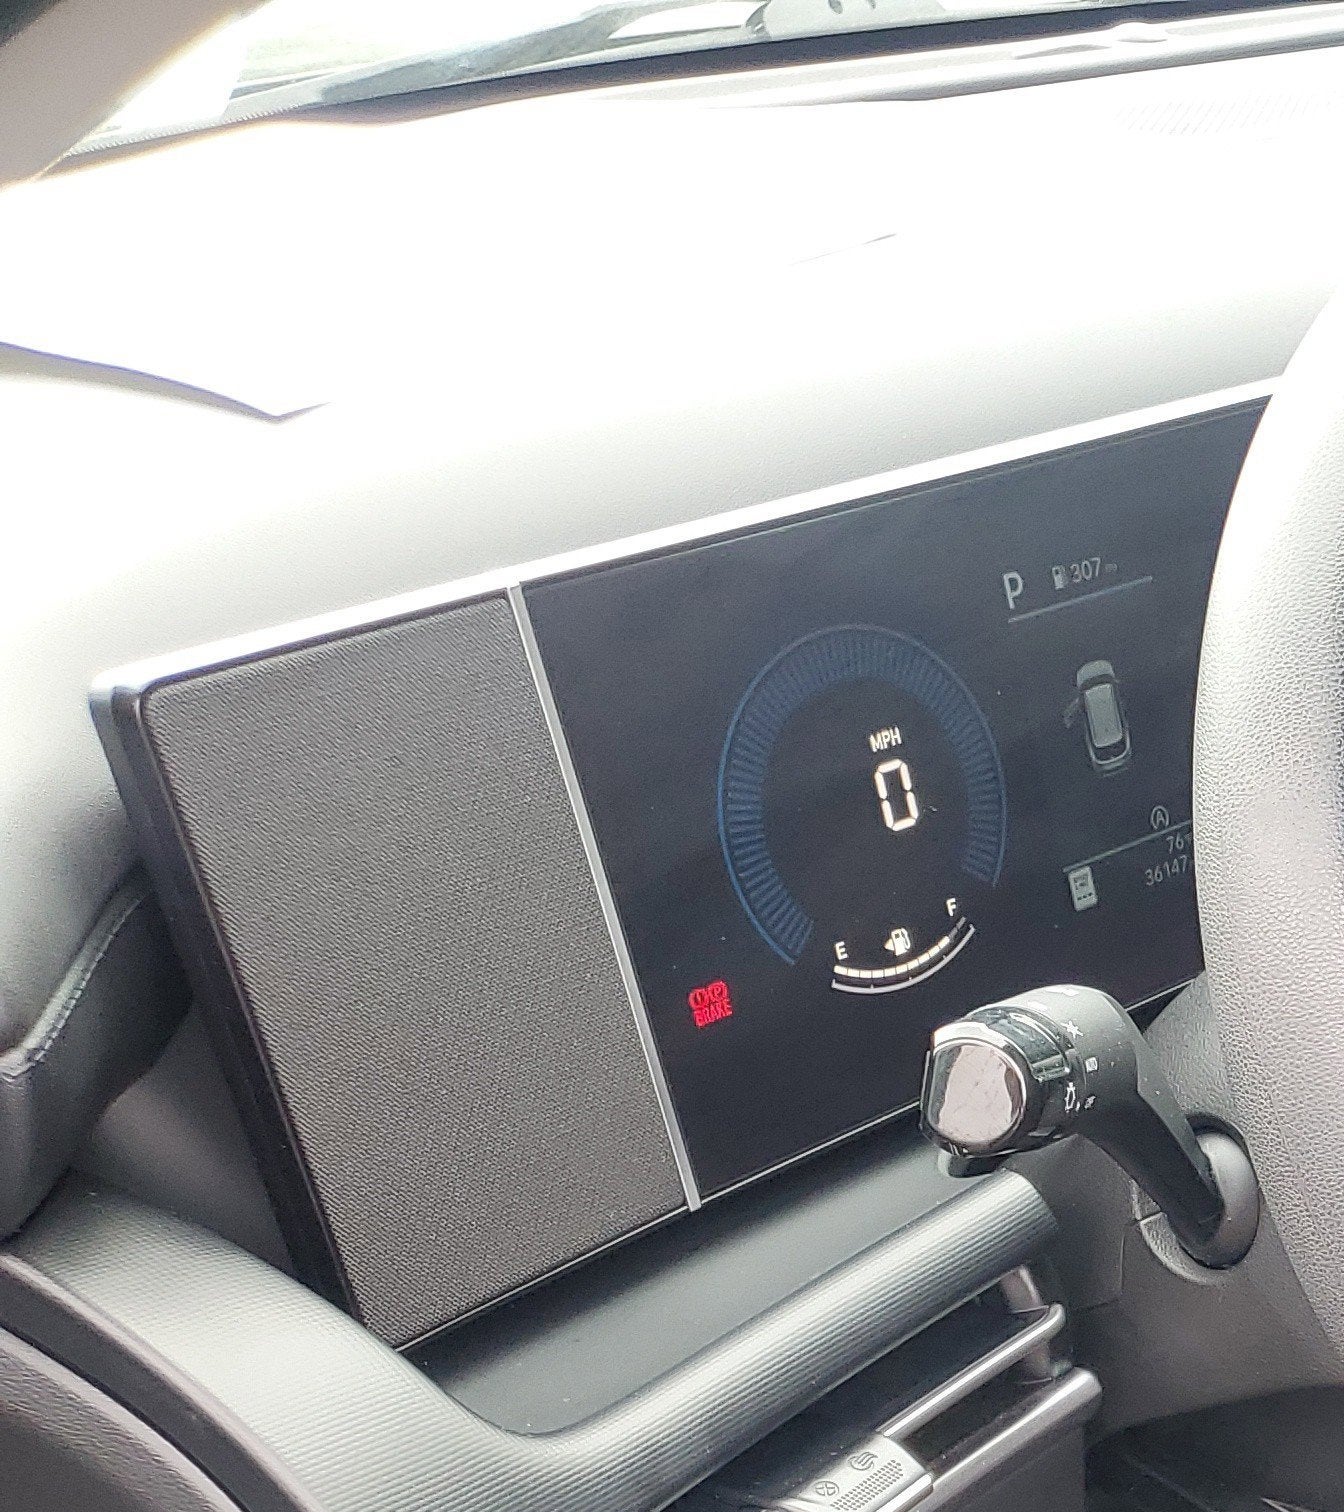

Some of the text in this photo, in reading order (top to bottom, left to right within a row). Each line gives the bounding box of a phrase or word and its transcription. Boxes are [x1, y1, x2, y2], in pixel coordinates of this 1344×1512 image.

[1069, 557, 1101, 583] 307
[1004, 571, 1023, 609] P
[869, 727, 902, 752] MPH
[874, 758, 919, 832] 0
[946, 898, 957, 917] F
[834, 941, 849, 960] E
